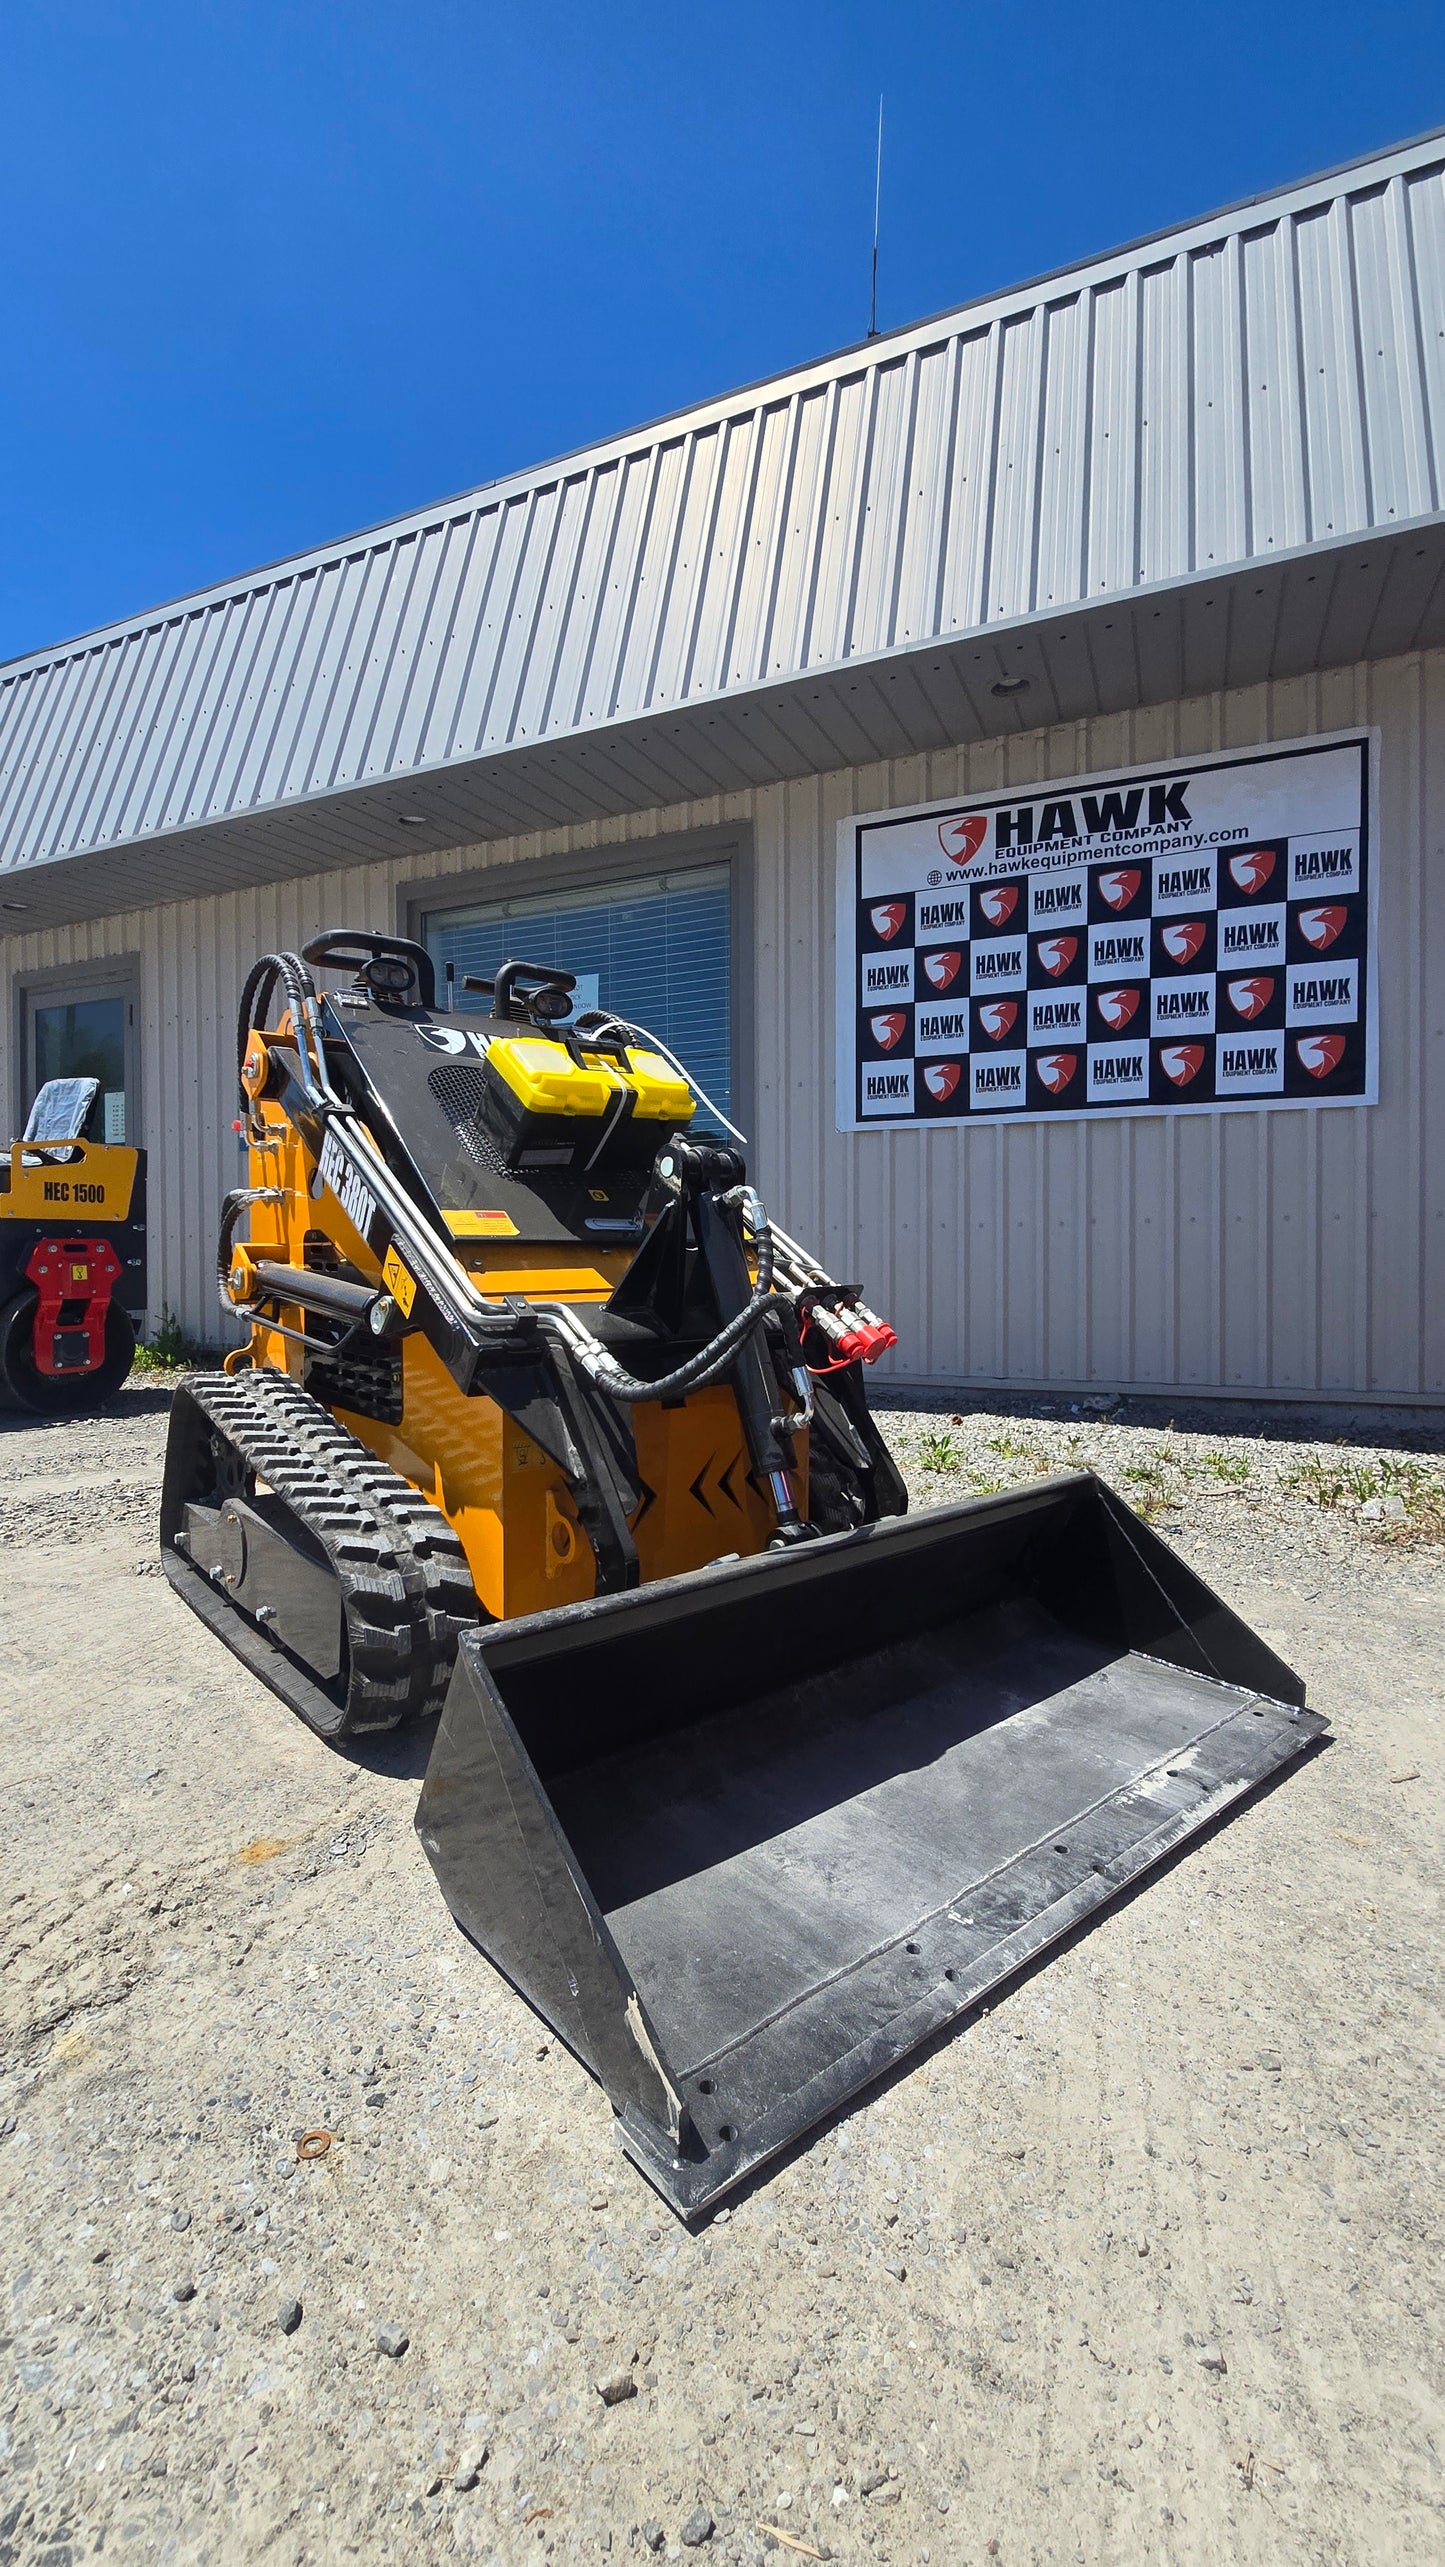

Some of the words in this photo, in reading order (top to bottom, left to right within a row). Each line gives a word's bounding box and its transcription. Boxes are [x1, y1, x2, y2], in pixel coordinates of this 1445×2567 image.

[995, 781, 1192, 849] HAWK
[995, 835, 1094, 860] EQUIPMENT
[1100, 820, 1193, 843] COMPANY
[945, 827, 1249, 882] www.hawkequipmentcompany.com
[1295, 848, 1352, 875] HAWK
[1158, 867, 1211, 894] HAWK
[1295, 873, 1324, 882] EQUIPMENT
[1326, 870, 1352, 878] COMPANY
[1034, 884, 1082, 909] HAWK
[1158, 891, 1186, 900] EQUIPMENT
[1187, 887, 1211, 896] COMPANY
[921, 902, 964, 924] HAWK
[1034, 906, 1059, 915] EQUIPMENT
[1060, 904, 1082, 912] COMPANY
[921, 922, 943, 930] EQUIPMENT
[1224, 921, 1279, 947] HAWK
[1094, 936, 1144, 961] HAWK
[1224, 945, 1252, 953] EQUIPMENT
[1254, 942, 1279, 951] COMPANY
[976, 951, 1021, 974] HAWK
[1094, 958, 1120, 967] EQUIPMENT
[1121, 956, 1144, 964] COMPANY
[868, 965, 909, 986] HAWK
[976, 972, 1000, 980] EQUIPMENT
[1001, 970, 1022, 978] COMPANY
[867, 984, 889, 992] EQUIPMENT
[890, 982, 910, 990] COMPANY
[1293, 978, 1350, 1003] HAWK
[1033, 1002, 1081, 1025] HAWK
[1157, 991, 1209, 1015] HAWK
[1293, 1001, 1322, 1009] EQUIPMENT
[1324, 999, 1350, 1007] COMPANY
[920, 1014, 964, 1035] HAWK
[1033, 1023, 1057, 1031] EQUIPMENT
[1093, 1056, 1143, 1079] HAWK
[1223, 1048, 1277, 1071] HAWK
[976, 1066, 1021, 1087] HAWK
[1093, 1077, 1119, 1085] EQUIPMENT
[1222, 1069, 1251, 1077] EQUIPMENT
[1253, 1068, 1278, 1076] COMPANY
[867, 1075, 909, 1094] HAWK
[976, 1086, 999, 1094] EQUIPMENT
[44, 1181, 69, 1202] HEC
[72, 1183, 105, 1203] 1500
[319, 1129, 345, 1194] HEC
[341, 1163, 377, 1241] 380T
